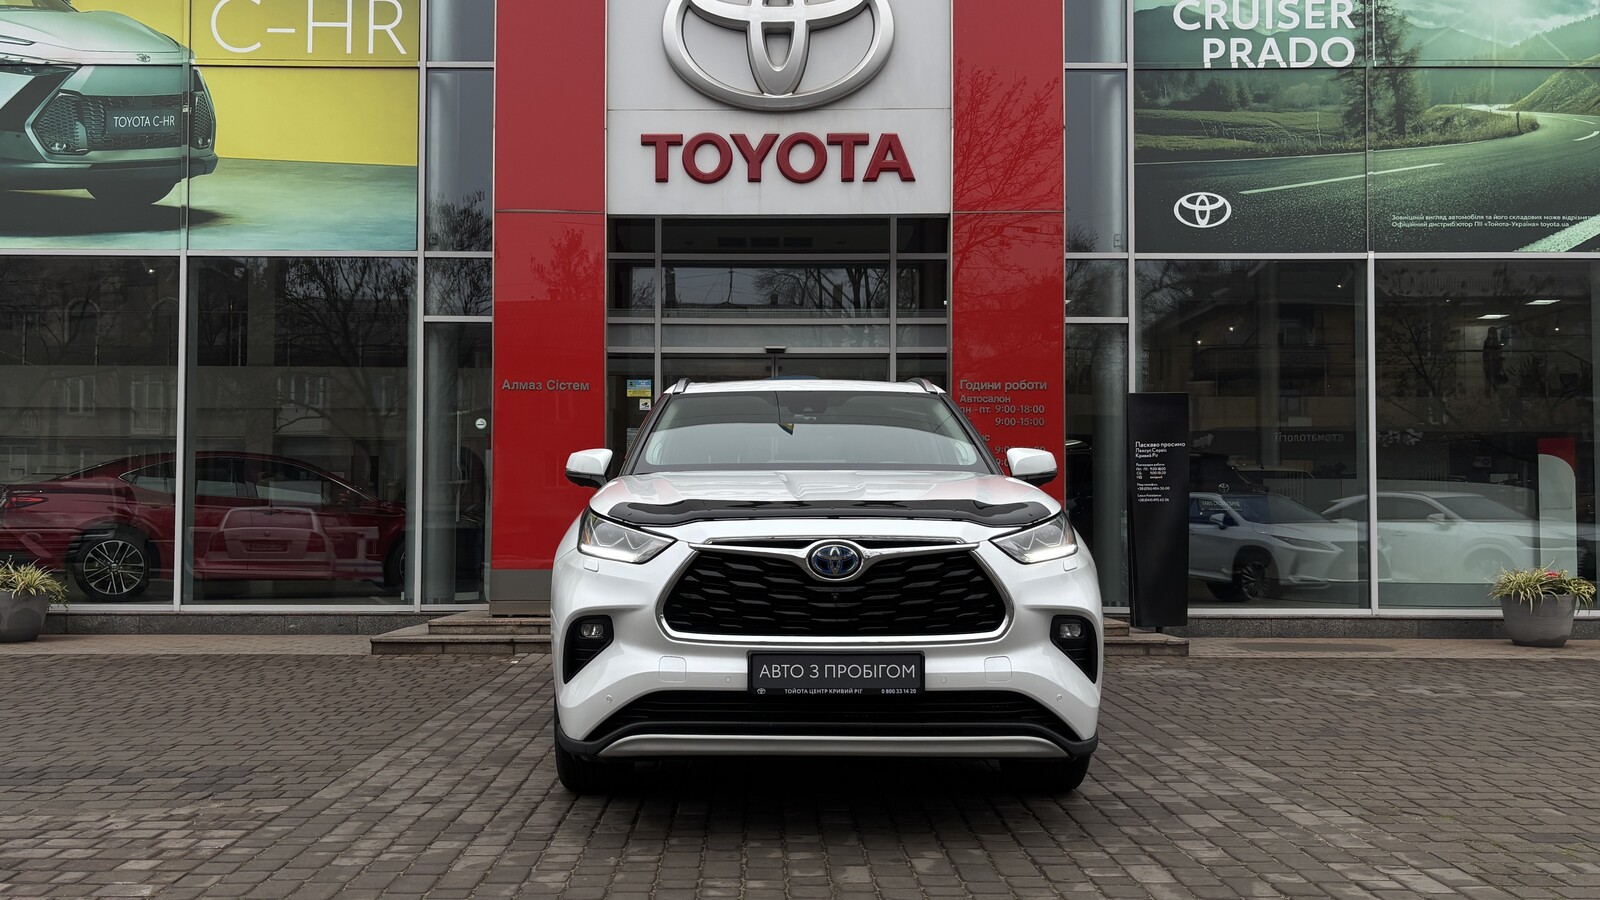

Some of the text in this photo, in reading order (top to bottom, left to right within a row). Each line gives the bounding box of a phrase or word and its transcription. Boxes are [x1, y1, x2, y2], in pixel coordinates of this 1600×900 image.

[1172, 0, 1356, 31] CRUISER
[210, 0, 407, 54] C-HR
[1203, 37, 1356, 69] PRADO
[113, 115, 176, 128] TOYOTA C-HR
[640, 132, 917, 184] TOYOTA
[1448, 213, 1485, 221] автомобіля
[1540, 221, 1570, 229] toyota.ua
[501, 379, 590, 391] Алмаз Сістем
[959, 379, 1047, 393] Години роботи
[959, 394, 1011, 404] Автосалон
[995, 404, 1045, 414] 9:00-18:00
[995, 417, 1045, 426] 9:00-15:00
[758, 663, 916, 679] АВТО З ПРОБІГОМ
[784, 687, 809, 695] ТОЙОТА
